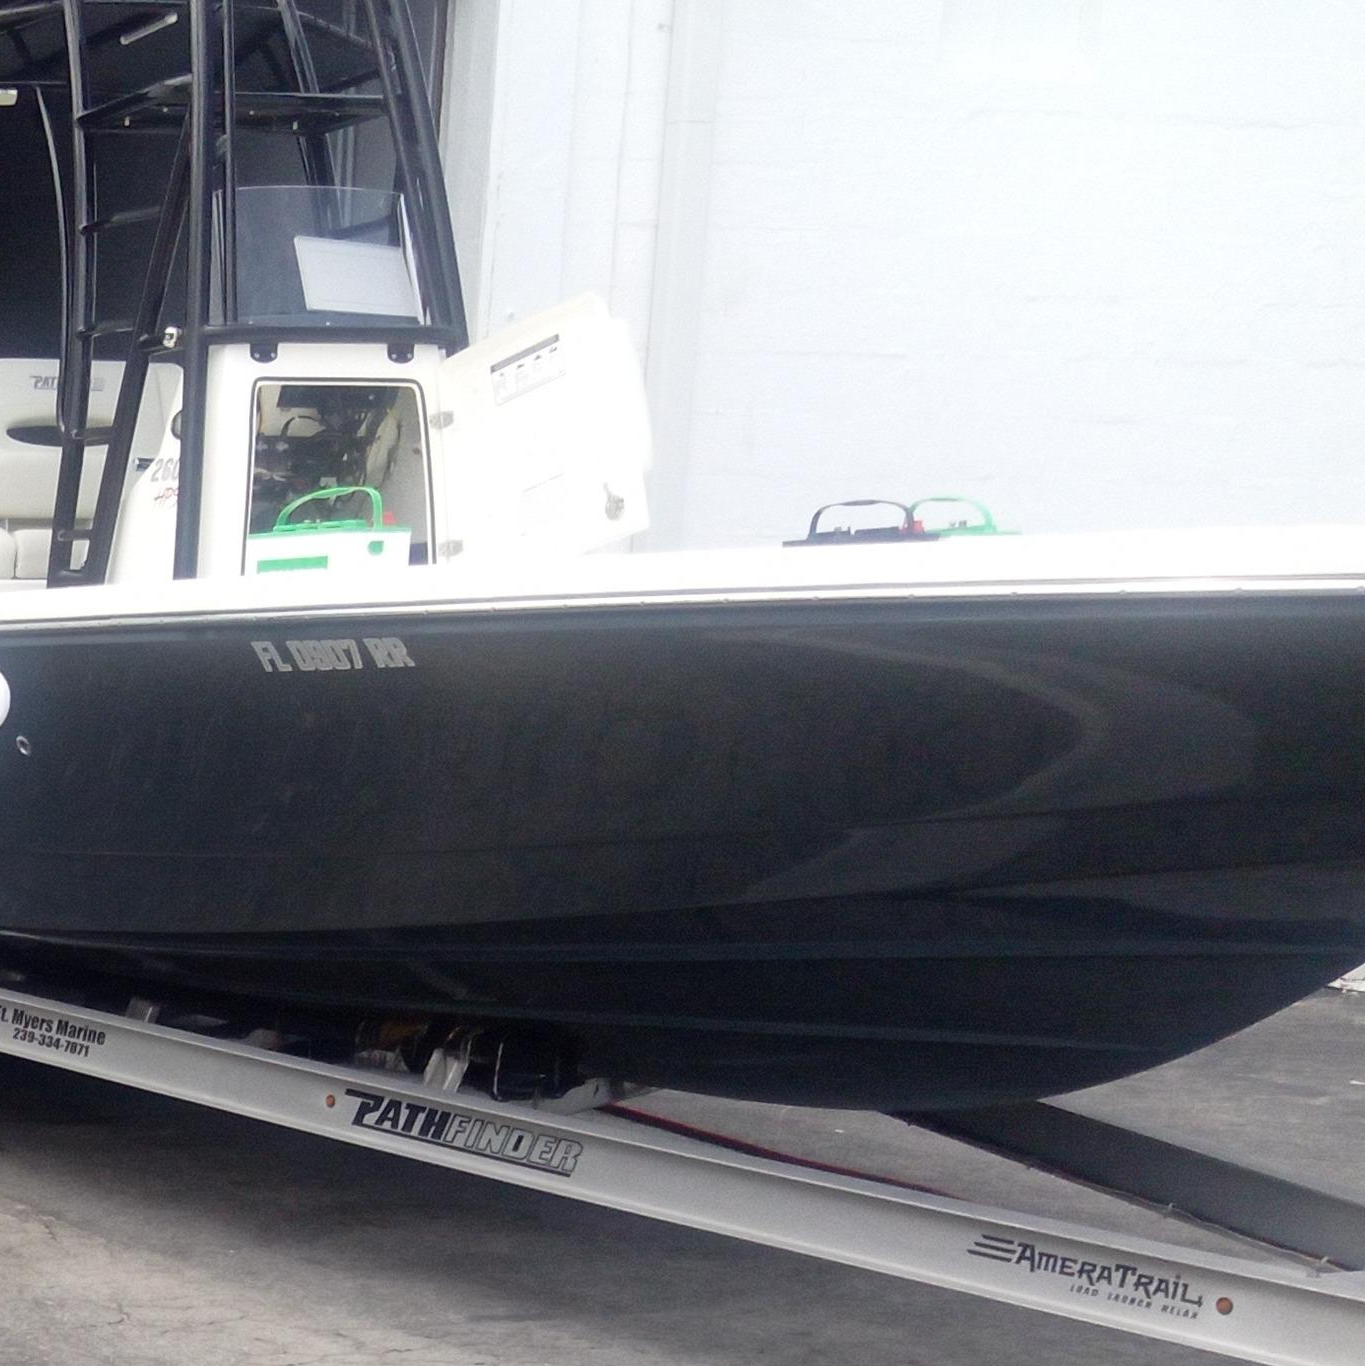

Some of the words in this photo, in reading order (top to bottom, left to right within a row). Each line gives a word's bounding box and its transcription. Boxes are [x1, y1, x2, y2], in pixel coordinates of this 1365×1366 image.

[250, 641, 293, 672] FL
[286, 638, 363, 671] 0907
[363, 637, 416, 669] RR
[11, 1009, 53, 1034] Myers
[55, 1019, 106, 1046] Marine
[12, 1027, 91, 1057] 239-334-7871
[344, 1088, 584, 1174] PATHFINDER
[1160, 1304, 1199, 1320] RELAX
